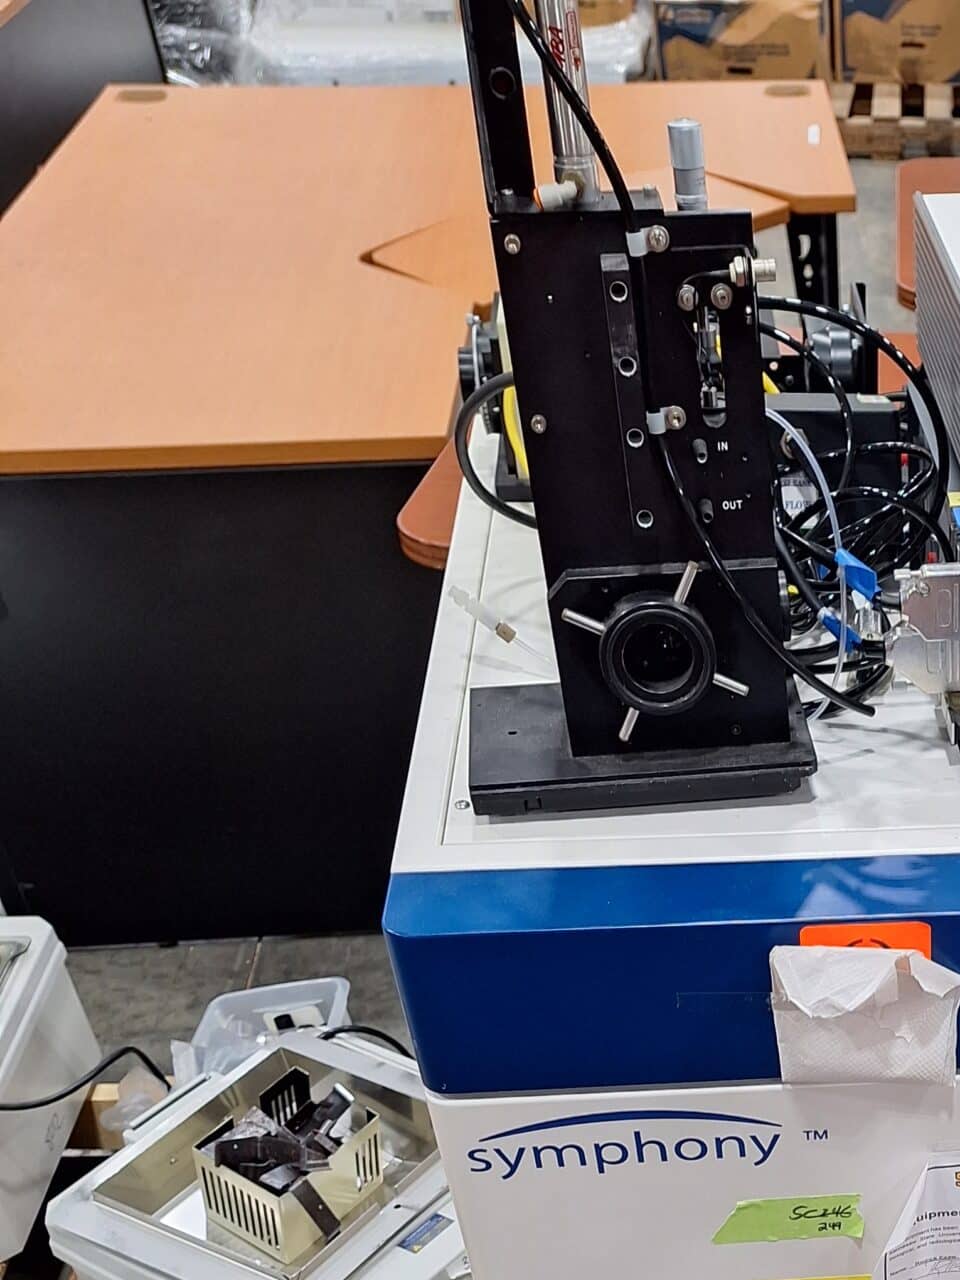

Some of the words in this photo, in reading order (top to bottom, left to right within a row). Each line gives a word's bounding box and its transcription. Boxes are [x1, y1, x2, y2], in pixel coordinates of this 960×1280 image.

[717, 440, 729, 452] IN
[722, 499, 743, 511] OUT
[466, 1130, 781, 1180] symphony
[803, 1129, 829, 1141] TM
